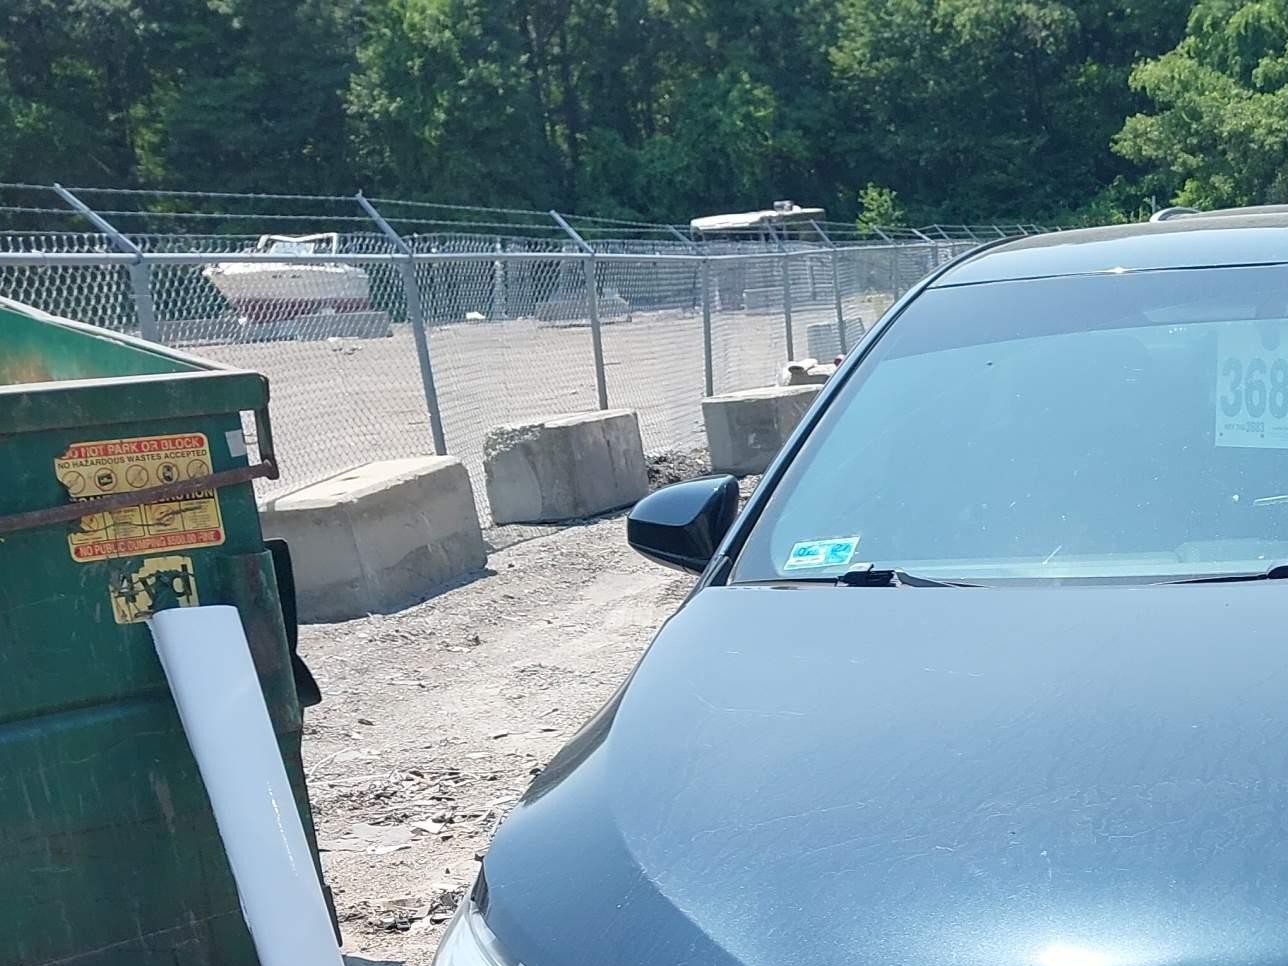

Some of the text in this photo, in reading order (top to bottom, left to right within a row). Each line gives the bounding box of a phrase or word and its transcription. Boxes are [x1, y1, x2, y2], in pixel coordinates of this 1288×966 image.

[81, 445, 105, 458] NOT
[107, 441, 138, 455] PARK
[141, 440, 159, 452] OR
[161, 436, 201, 450] BLOCK
[58, 449, 207, 470] NO HAZARDOUS WASTES ACCEPTED
[80, 545, 93, 557] NO
[94, 541, 127, 555] PUBLIC
[128, 536, 166, 551] DUMPING
